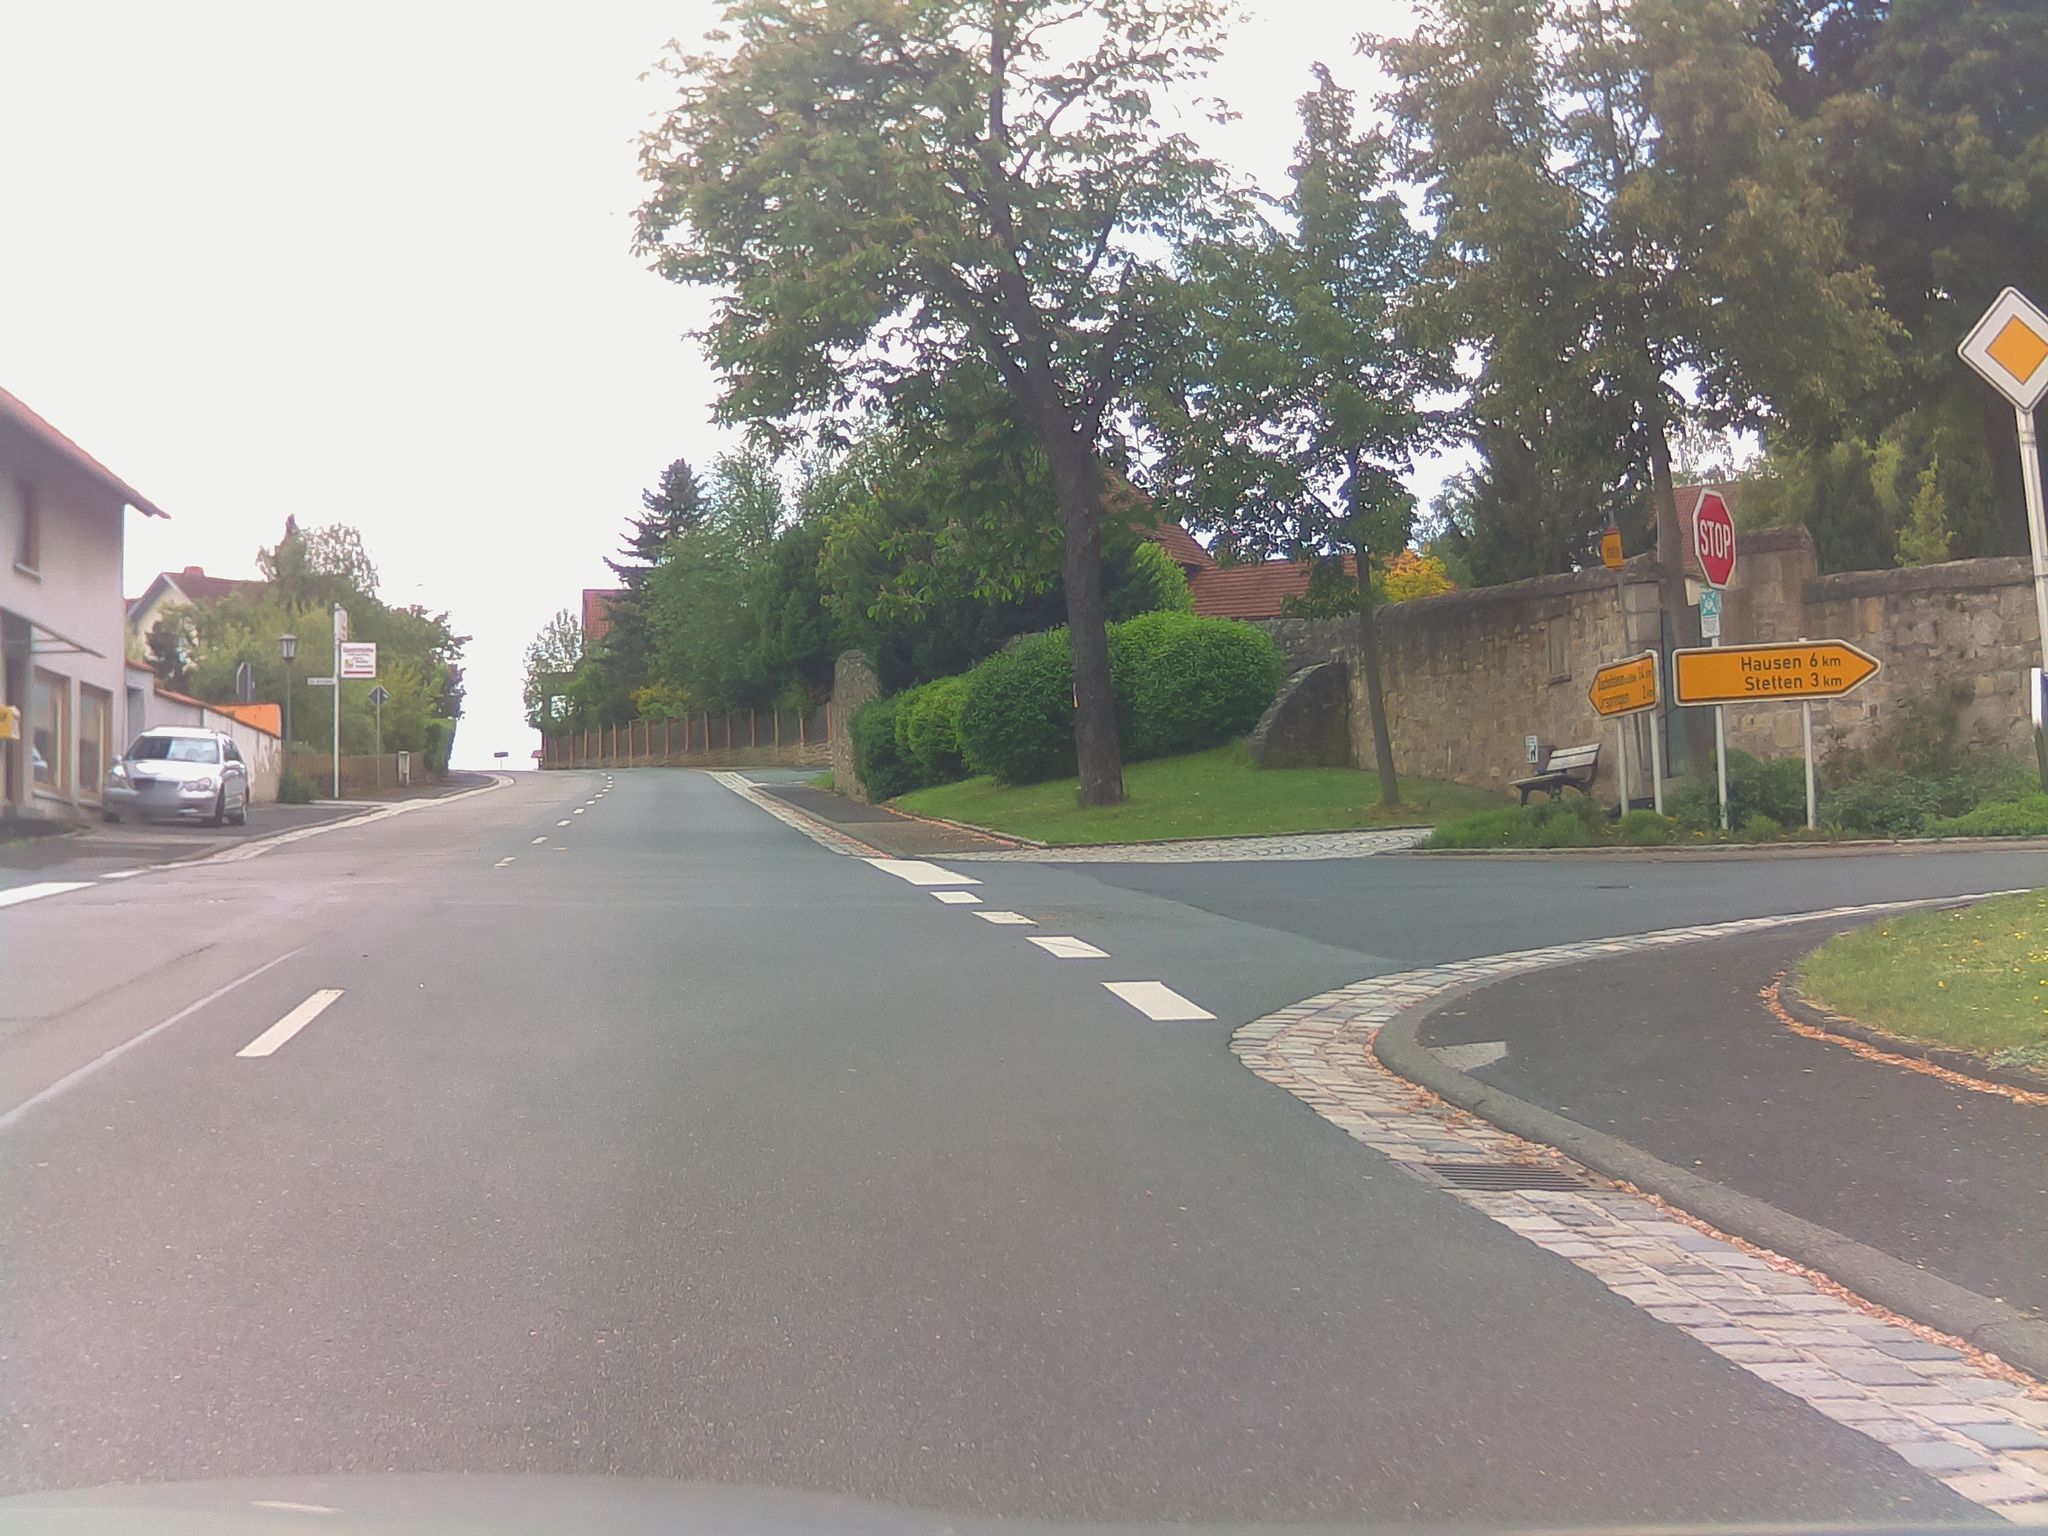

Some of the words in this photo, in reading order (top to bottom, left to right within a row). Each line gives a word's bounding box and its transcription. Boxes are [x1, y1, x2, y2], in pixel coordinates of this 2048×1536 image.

[1700, 519, 1731, 560] STOP
[1741, 656, 1801, 671] Hausen
[1810, 652, 1818, 667] 6
[1822, 656, 1841, 667] km
[1744, 675, 1803, 691] Stetten
[1810, 672, 1819, 687] 3
[1823, 675, 1842, 687] km
